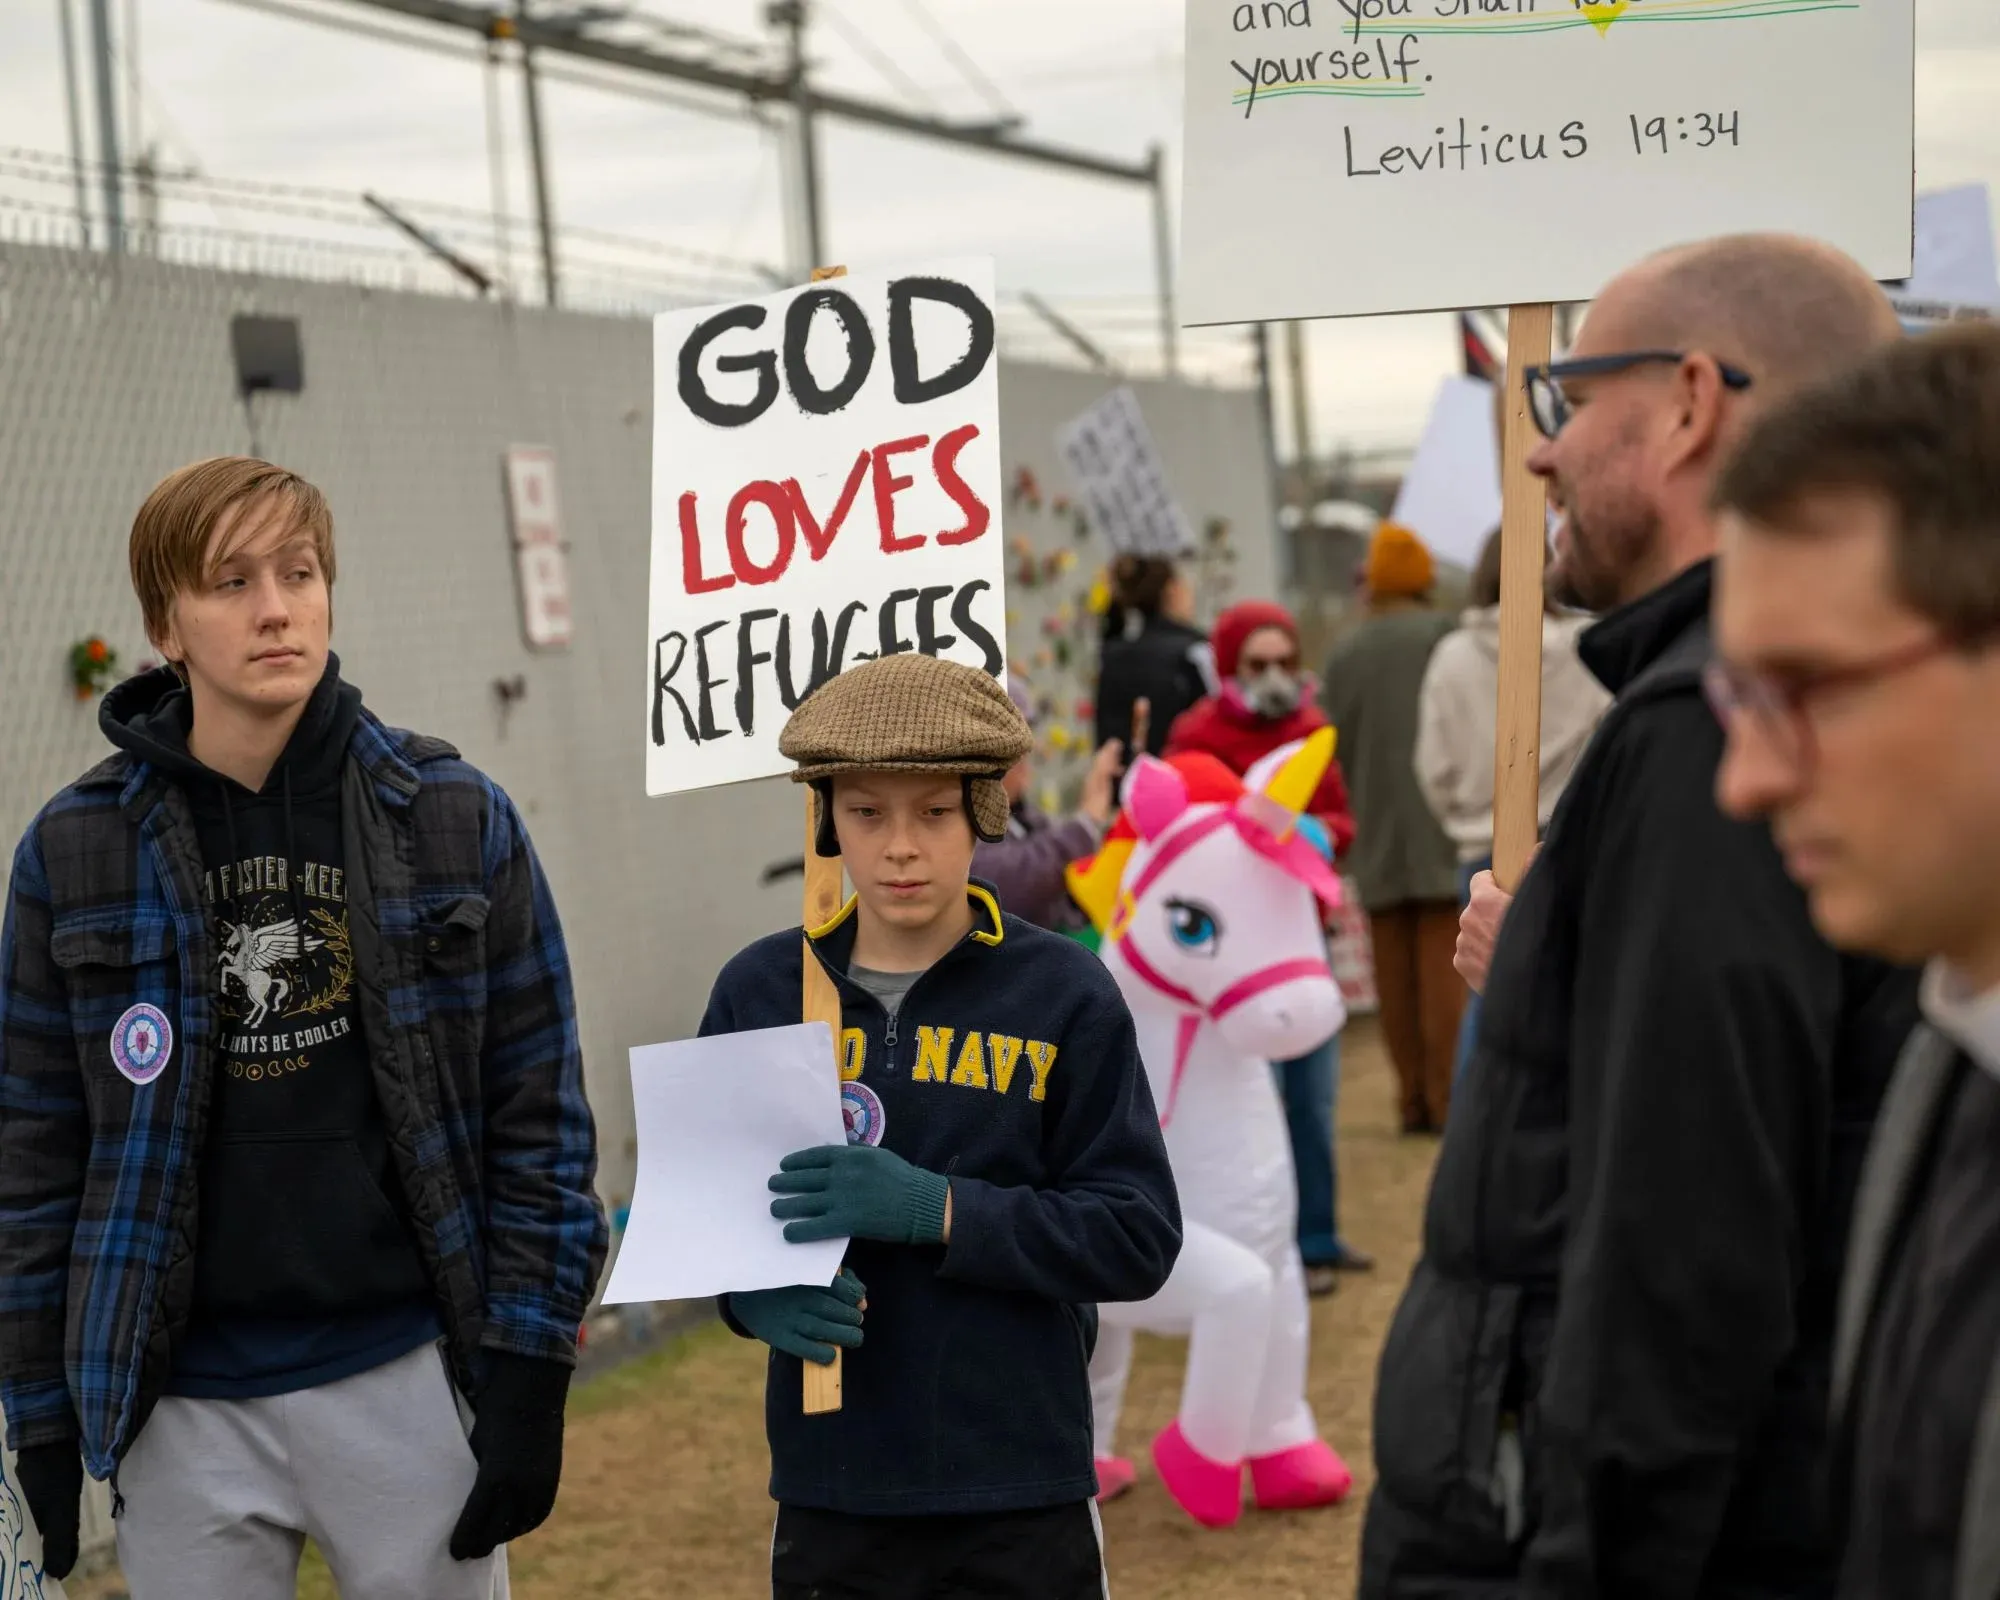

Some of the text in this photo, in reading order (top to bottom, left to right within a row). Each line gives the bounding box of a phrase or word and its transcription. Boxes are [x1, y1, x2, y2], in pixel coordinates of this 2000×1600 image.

[1233, 0, 1312, 32] and
[1231, 33, 1433, 119] yourself.
[1343, 110, 1739, 177] Leviticus 19:34
[677, 275, 996, 427] GOD
[678, 423, 991, 595] LOVES
[272, 1033, 291, 1052] BE
[294, 1016, 351, 1049] COOLER
[911, 1025, 1059, 1103] NAVY
